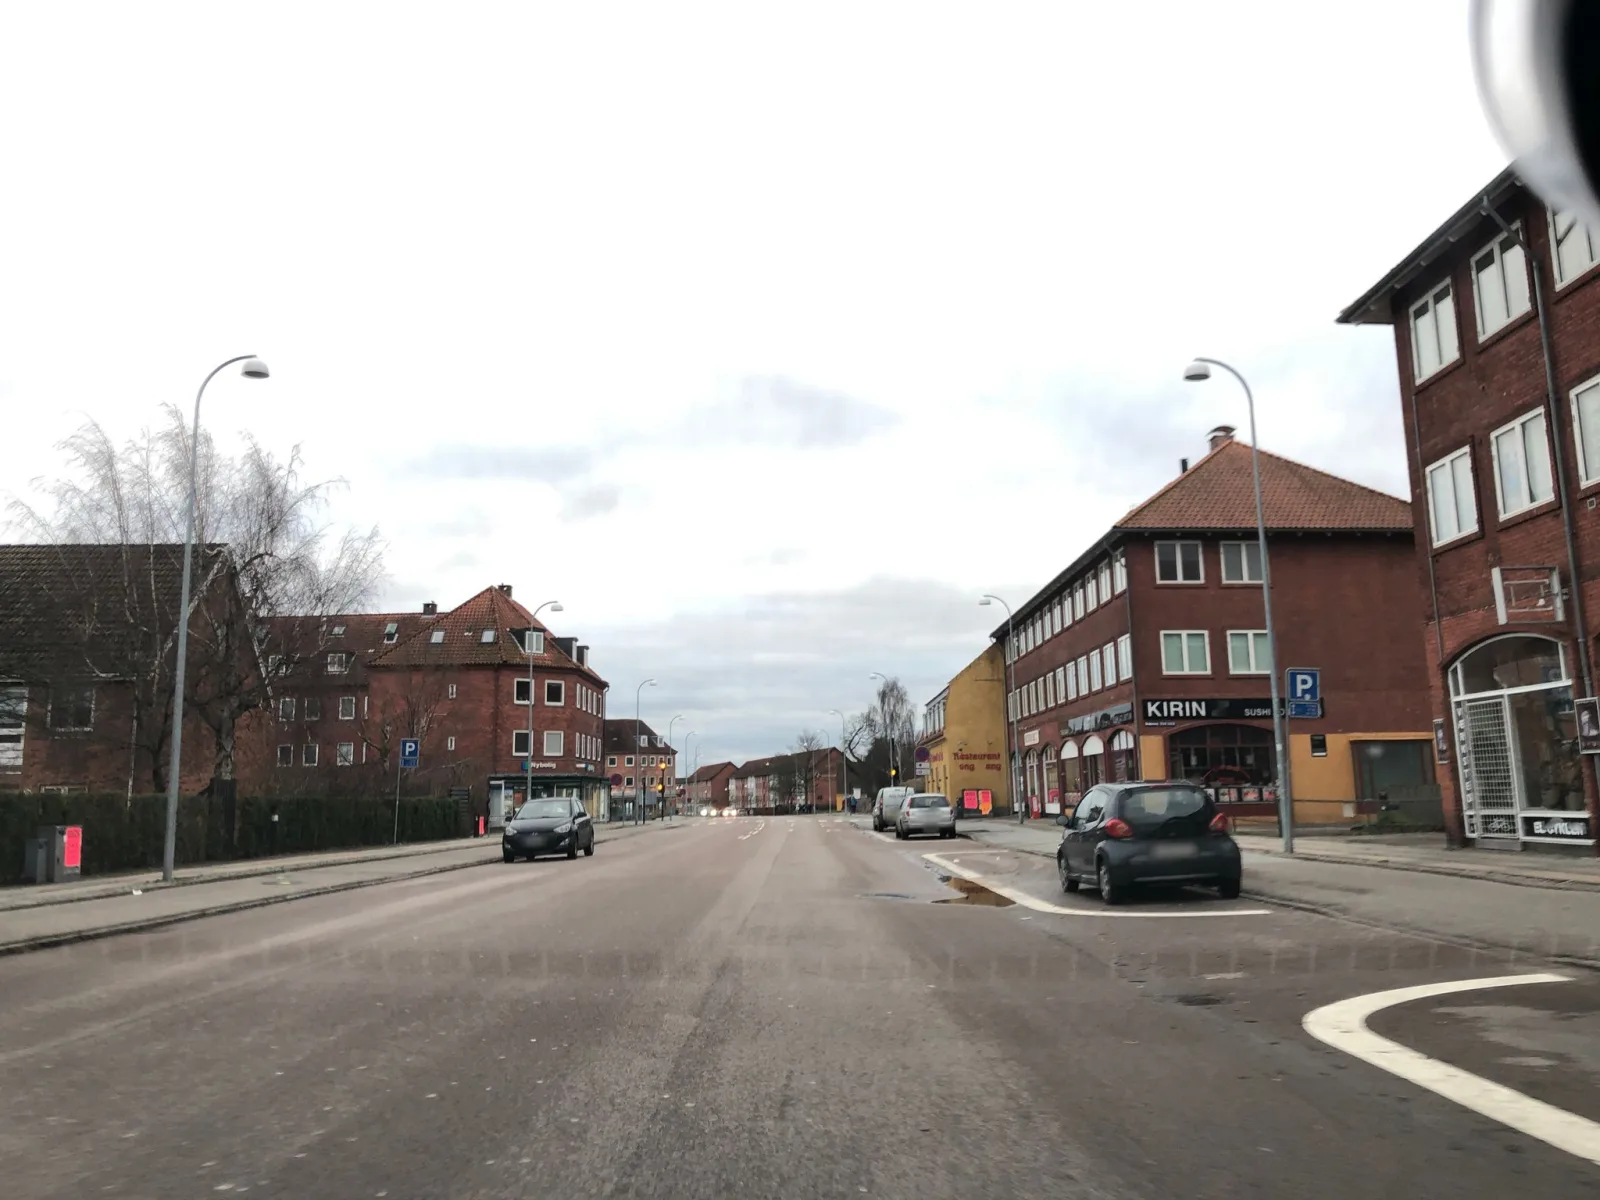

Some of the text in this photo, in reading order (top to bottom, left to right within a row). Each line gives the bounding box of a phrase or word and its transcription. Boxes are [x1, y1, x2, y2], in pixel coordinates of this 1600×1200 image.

[1296, 674, 1313, 697] P
[1147, 701, 1207, 717] KIRIN
[1244, 708, 1271, 716] SUSHI
[405, 742, 416, 756] P
